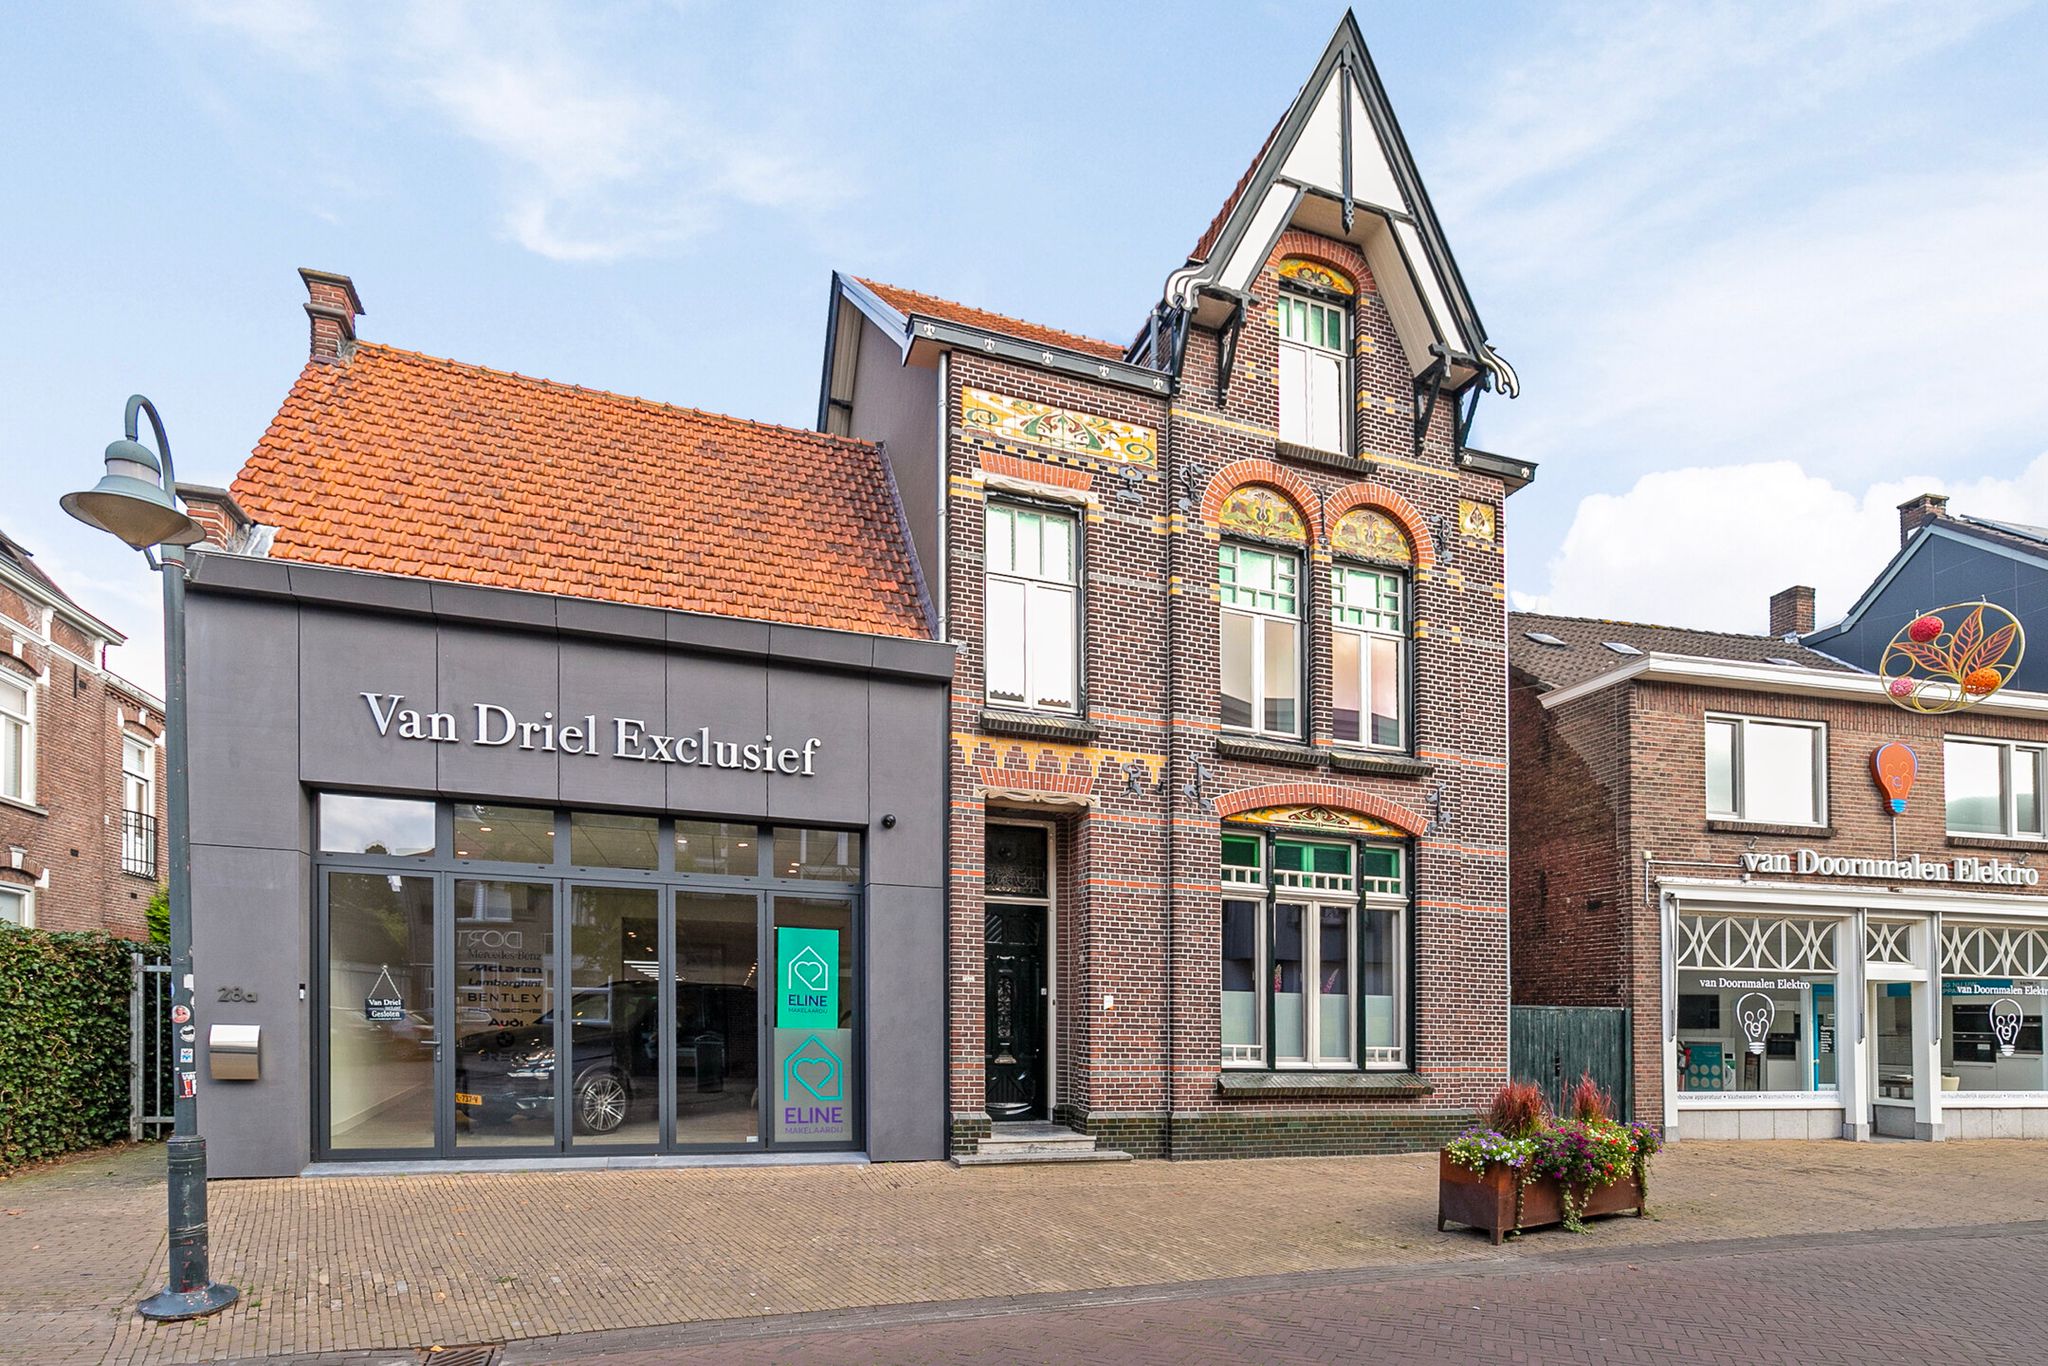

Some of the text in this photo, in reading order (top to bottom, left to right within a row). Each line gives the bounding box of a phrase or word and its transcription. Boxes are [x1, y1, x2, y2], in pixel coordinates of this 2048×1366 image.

[360, 692, 822, 776] Van Driel Exclusief
[1744, 849, 2040, 886] van Doornmalen Elektro
[468, 978, 541, 989] Lamborghini
[1700, 978, 1811, 989] van Doornmalen Elektro
[217, 986, 258, 1003] 28a
[1957, 986, 1972, 994] van
[1974, 985, 2023, 995] Doornmalen
[467, 993, 542, 1003] BENTLEY
[788, 994, 828, 1007] ELINE
[371, 1010, 400, 1018] Gesloten
[784, 1107, 843, 1124] ELINE
